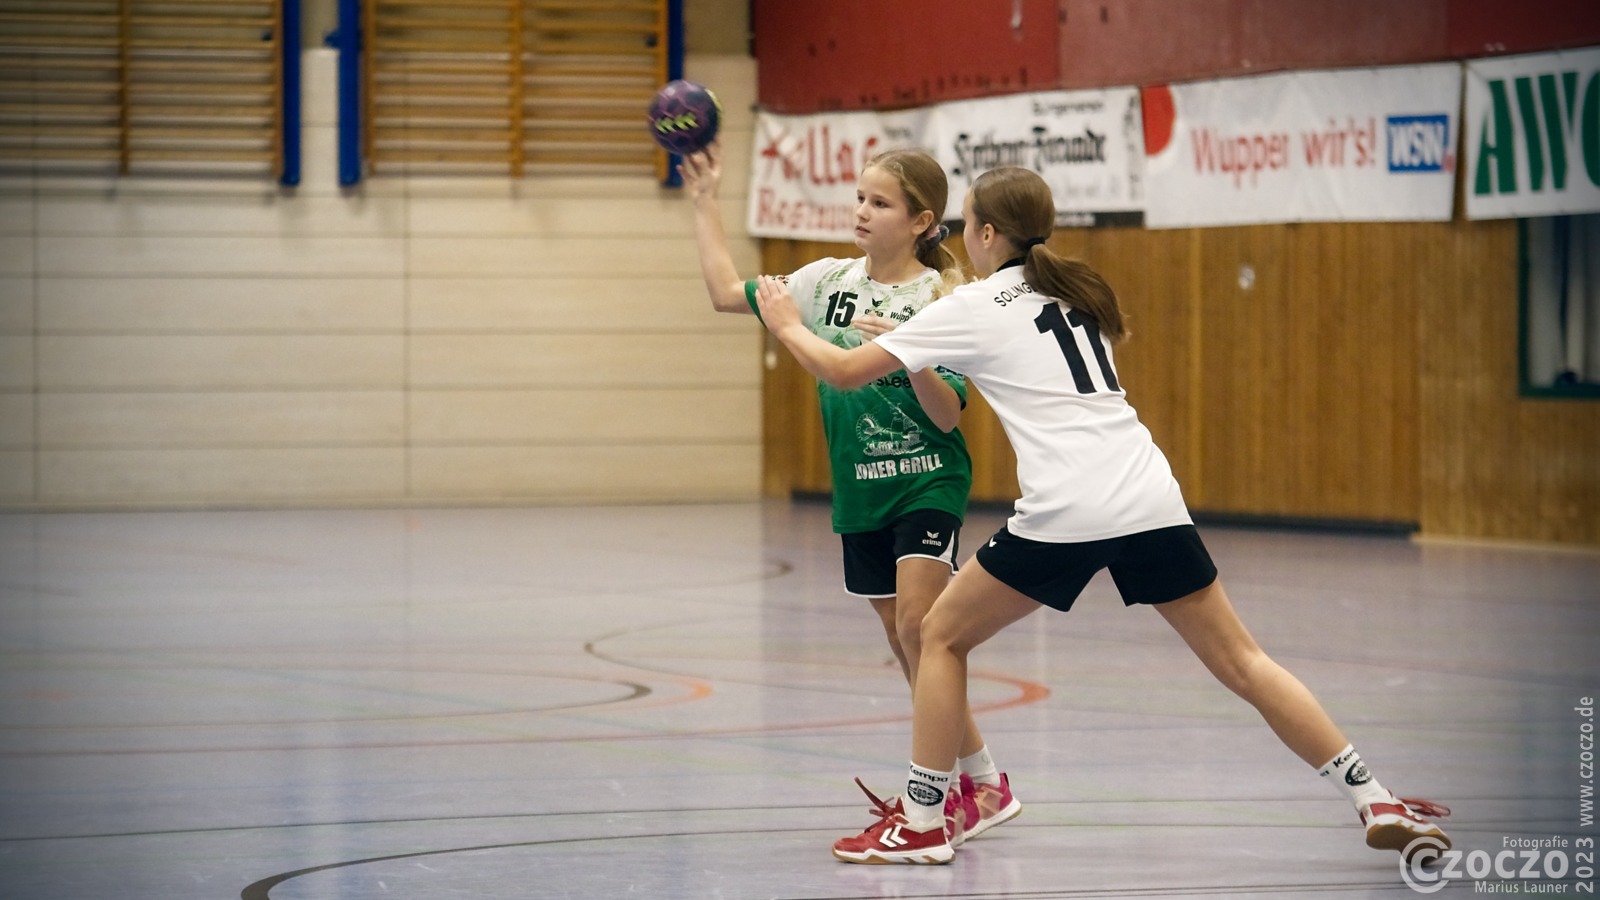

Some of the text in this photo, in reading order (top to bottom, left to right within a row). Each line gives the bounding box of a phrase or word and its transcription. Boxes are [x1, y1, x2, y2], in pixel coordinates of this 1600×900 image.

[1190, 126, 1289, 189] Wupper
[1302, 116, 1377, 168] wir's!
[1389, 120, 1445, 168] WSW
[824, 290, 859, 328] 15
[864, 308, 884, 318] ema
[889, 311, 910, 323] Wupp
[1033, 301, 1122, 395] 11
[900, 453, 943, 475] GRILL
[921, 538, 942, 548] erima
